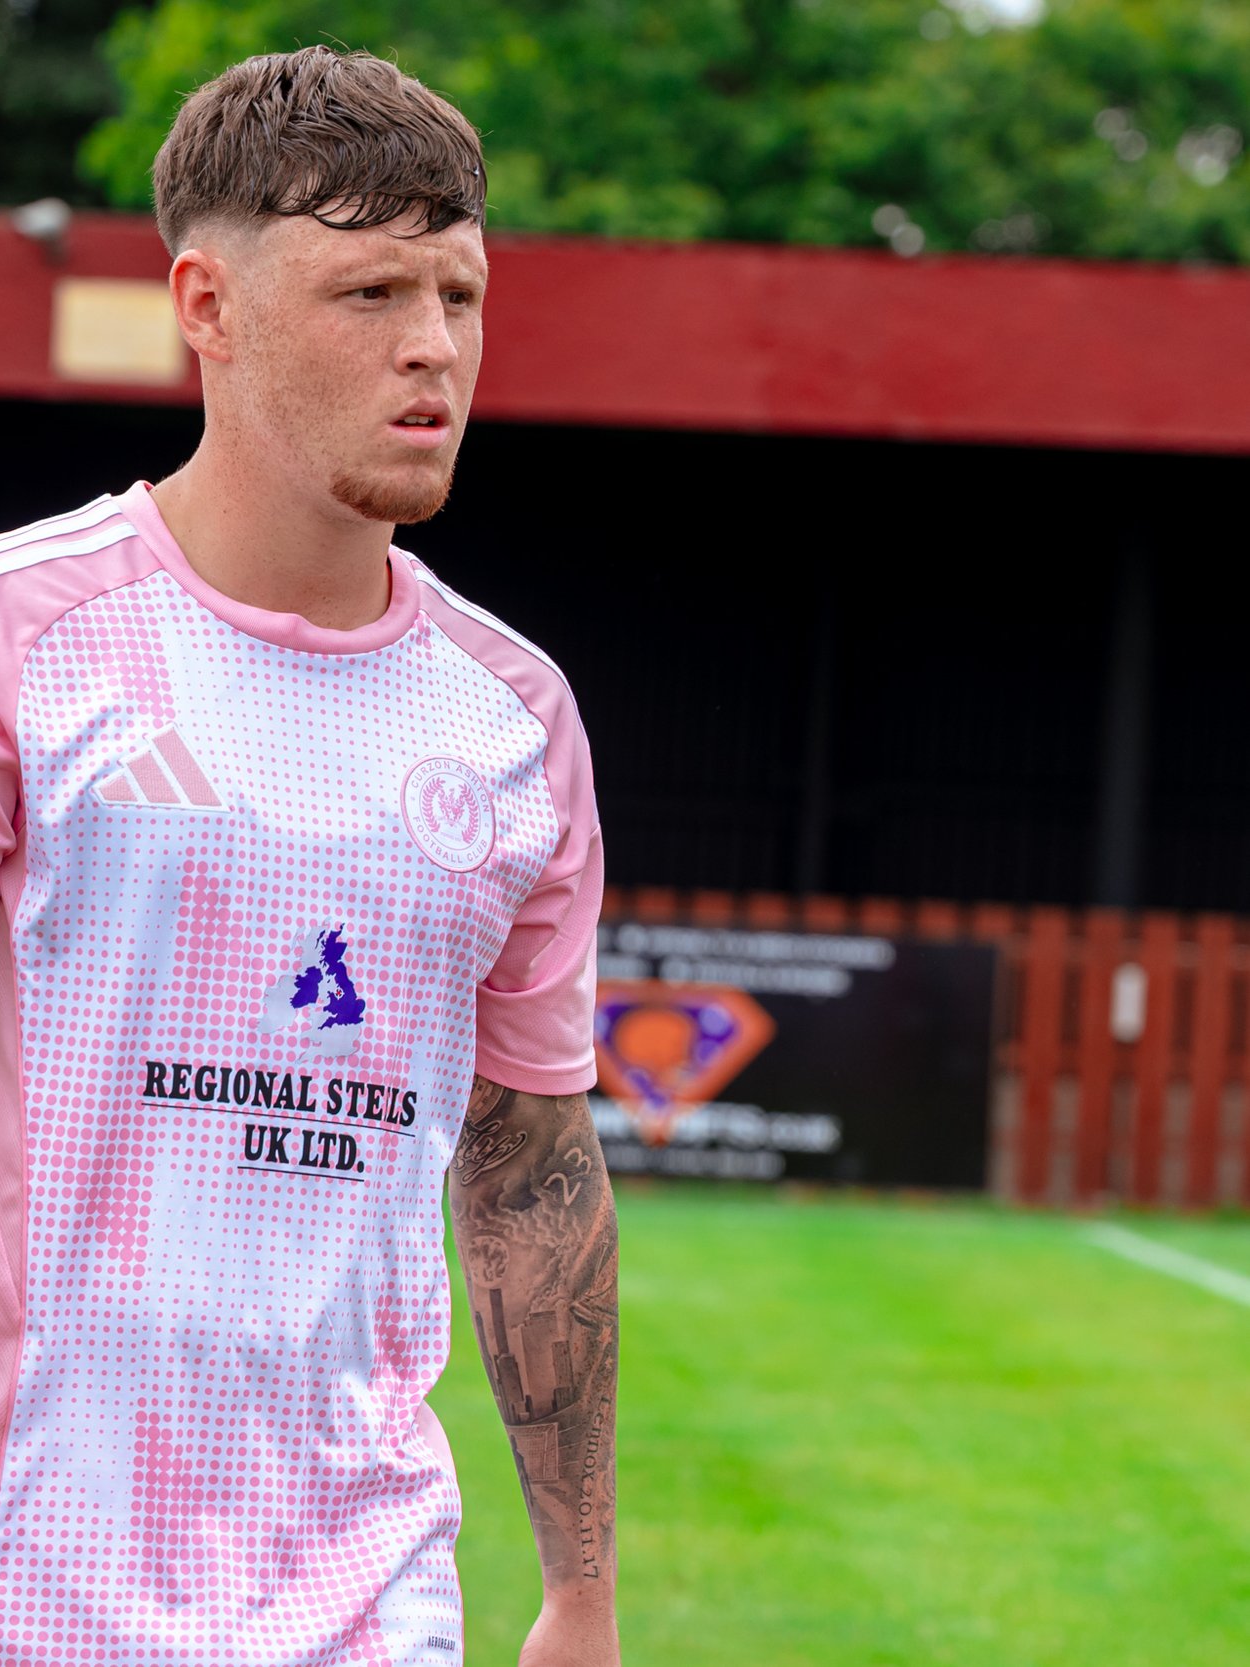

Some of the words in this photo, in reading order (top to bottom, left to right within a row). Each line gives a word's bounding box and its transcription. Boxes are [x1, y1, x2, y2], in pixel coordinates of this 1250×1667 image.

[411, 760, 451, 788] CURZON
[456, 764, 490, 812] ASHTON
[413, 815, 463, 864] FOOTBALL
[467, 839, 488, 862] CLUB
[143, 1061, 316, 1112] REGIONAL
[326, 1078, 417, 1127] STELS
[244, 1124, 292, 1164] UK
[299, 1129, 365, 1173] LTD.
[578, 1489, 600, 1580] 20.11.17
